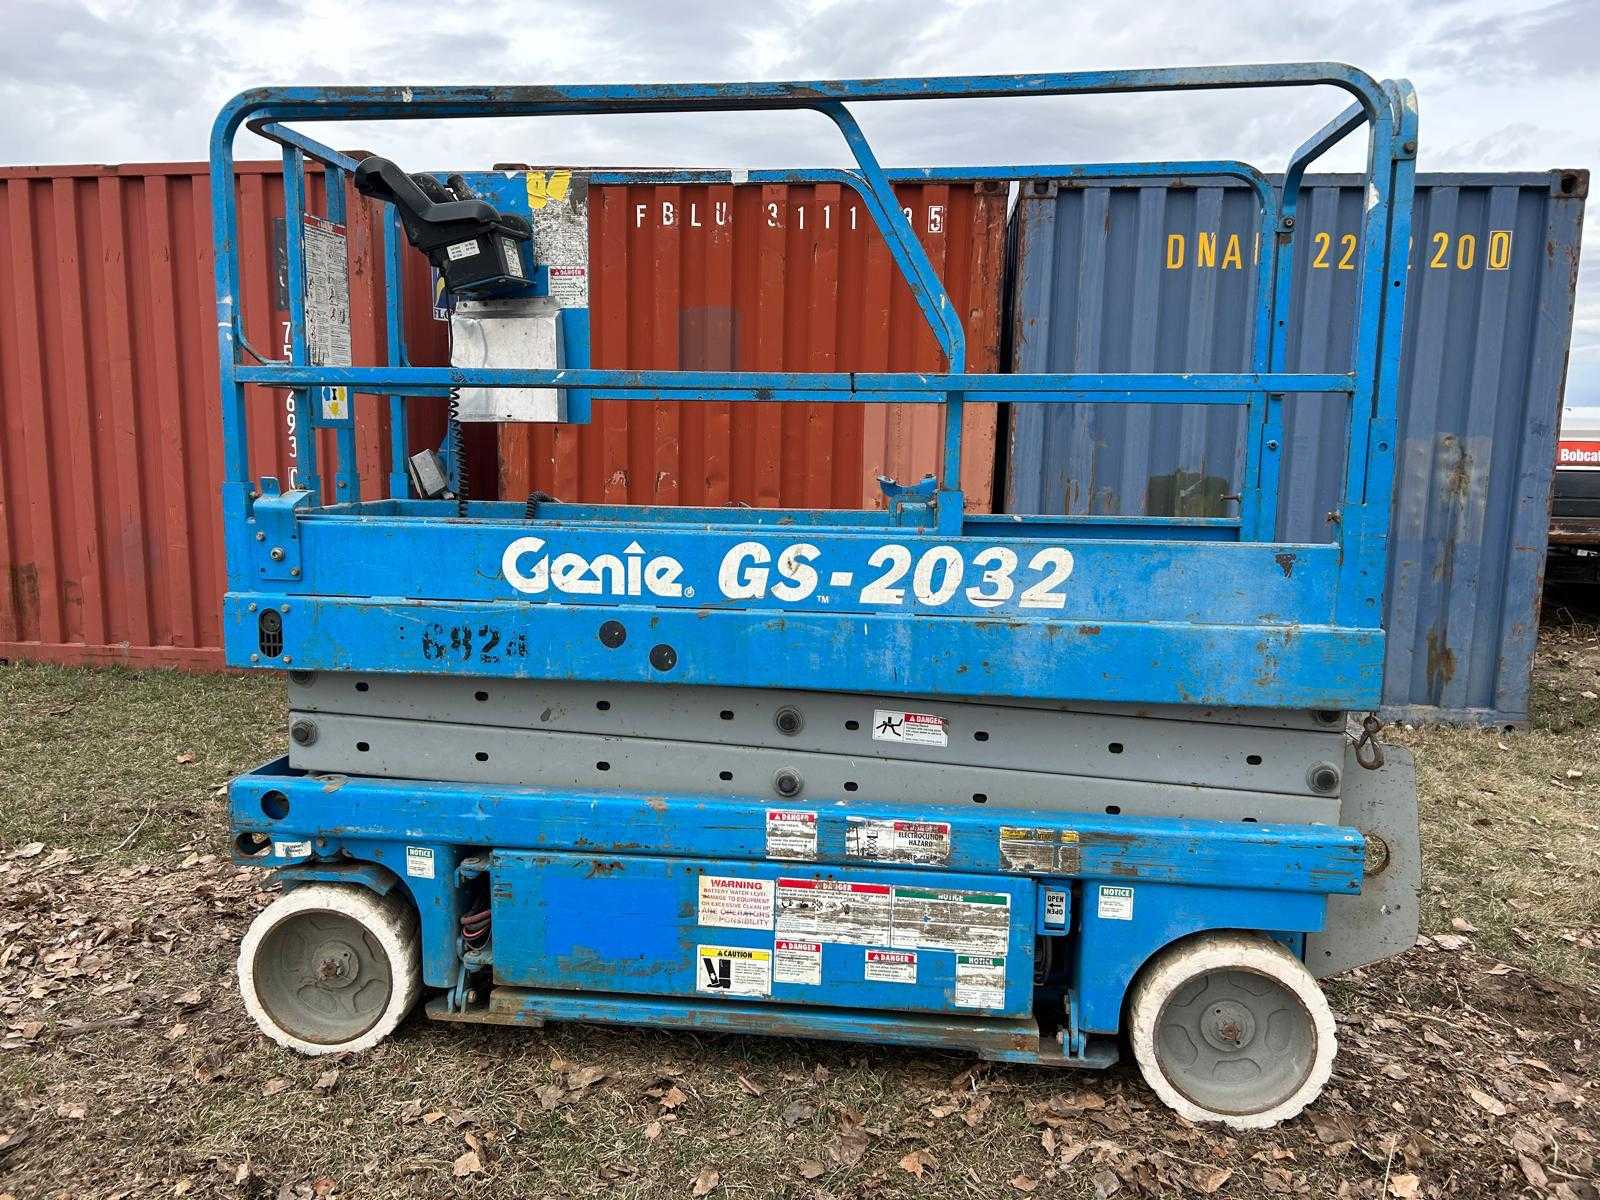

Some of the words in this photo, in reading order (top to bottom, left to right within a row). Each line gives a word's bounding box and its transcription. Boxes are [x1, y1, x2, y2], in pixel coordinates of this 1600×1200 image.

[636, 202, 727, 228] FBLU
[1166, 231, 1260, 269] DNA
[502, 537, 684, 597] Genie
[717, 541, 1075, 609] GS-2032
[916, 715, 942, 725] DANGER
[782, 813, 808, 822] DANGER
[898, 831, 944, 840] ELECTROCUTION
[908, 839, 933, 847] HAZARD
[410, 848, 431, 857] NOTICE
[711, 879, 763, 890] WARNING
[1103, 887, 1130, 897] NOTICE
[1047, 895, 1064, 903] OPEN
[788, 942, 817, 951] DANGER
[723, 950, 753, 959] CAUTION
[880, 953, 909, 962] DANGER
